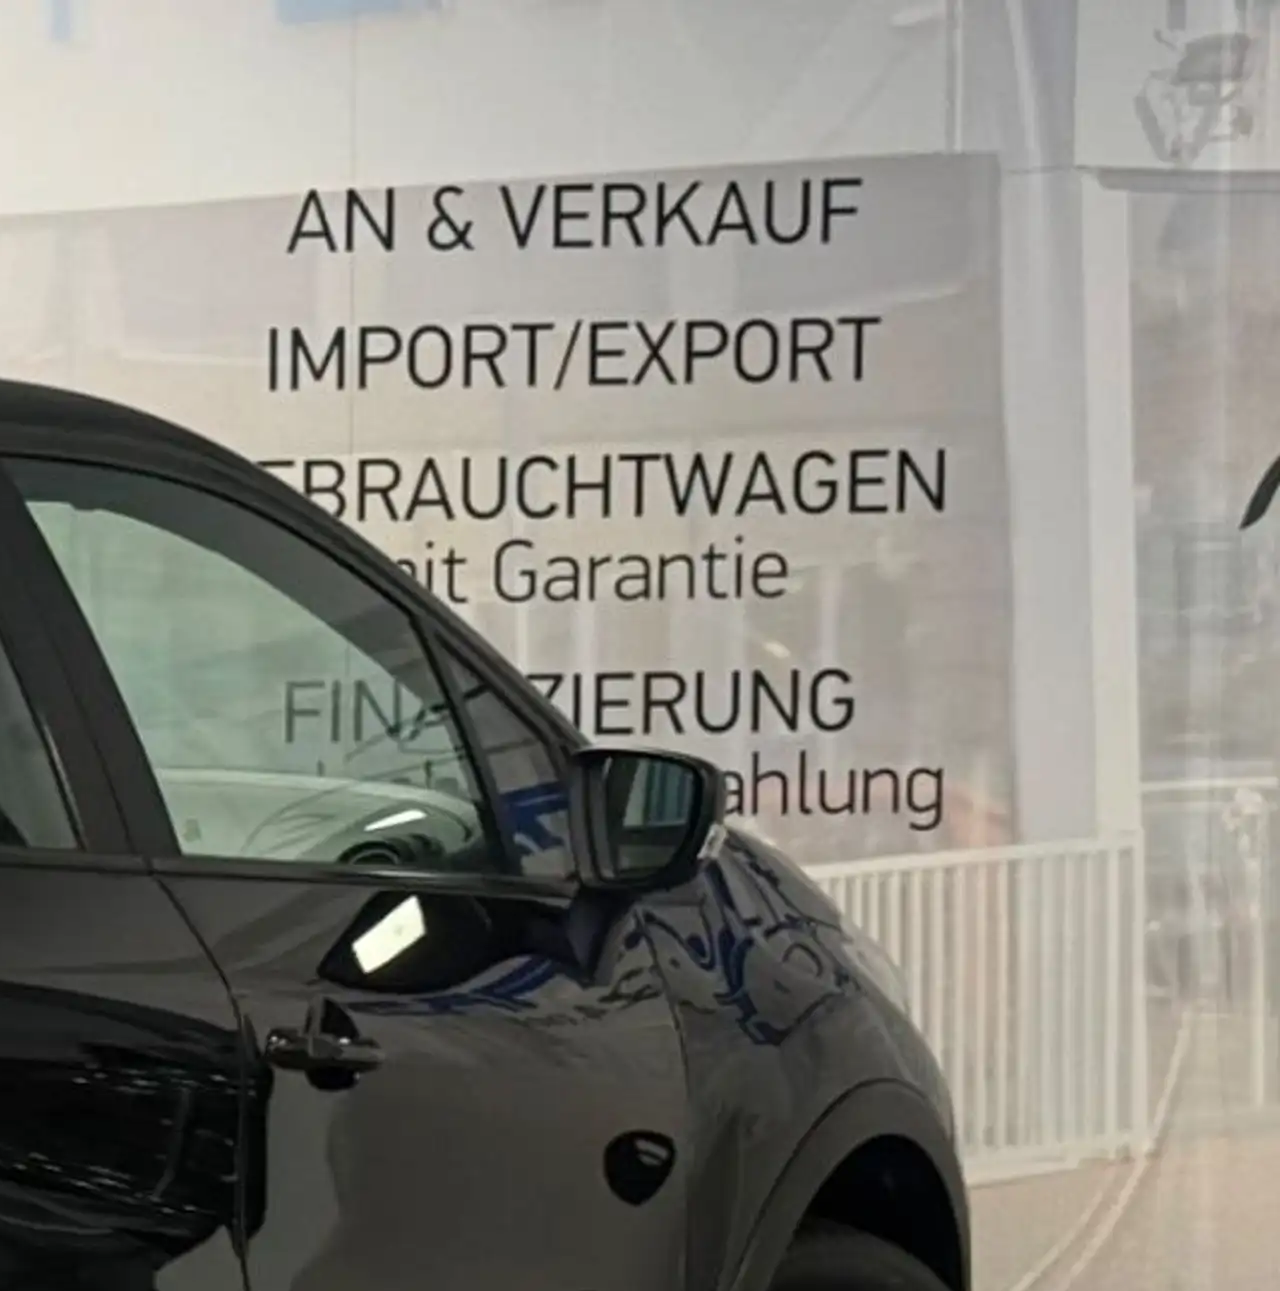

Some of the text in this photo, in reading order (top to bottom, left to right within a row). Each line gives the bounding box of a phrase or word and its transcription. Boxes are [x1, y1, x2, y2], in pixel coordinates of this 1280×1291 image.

[286, 177, 864, 254] AN & VERKAUF
[267, 316, 883, 391] IMPORT/EXPORT
[257, 449, 947, 522] BRAUCHTWAGEN
[493, 534, 790, 604] Garantie
[284, 668, 856, 744] FINZIERUNG
[722, 749, 945, 832] ahlung
